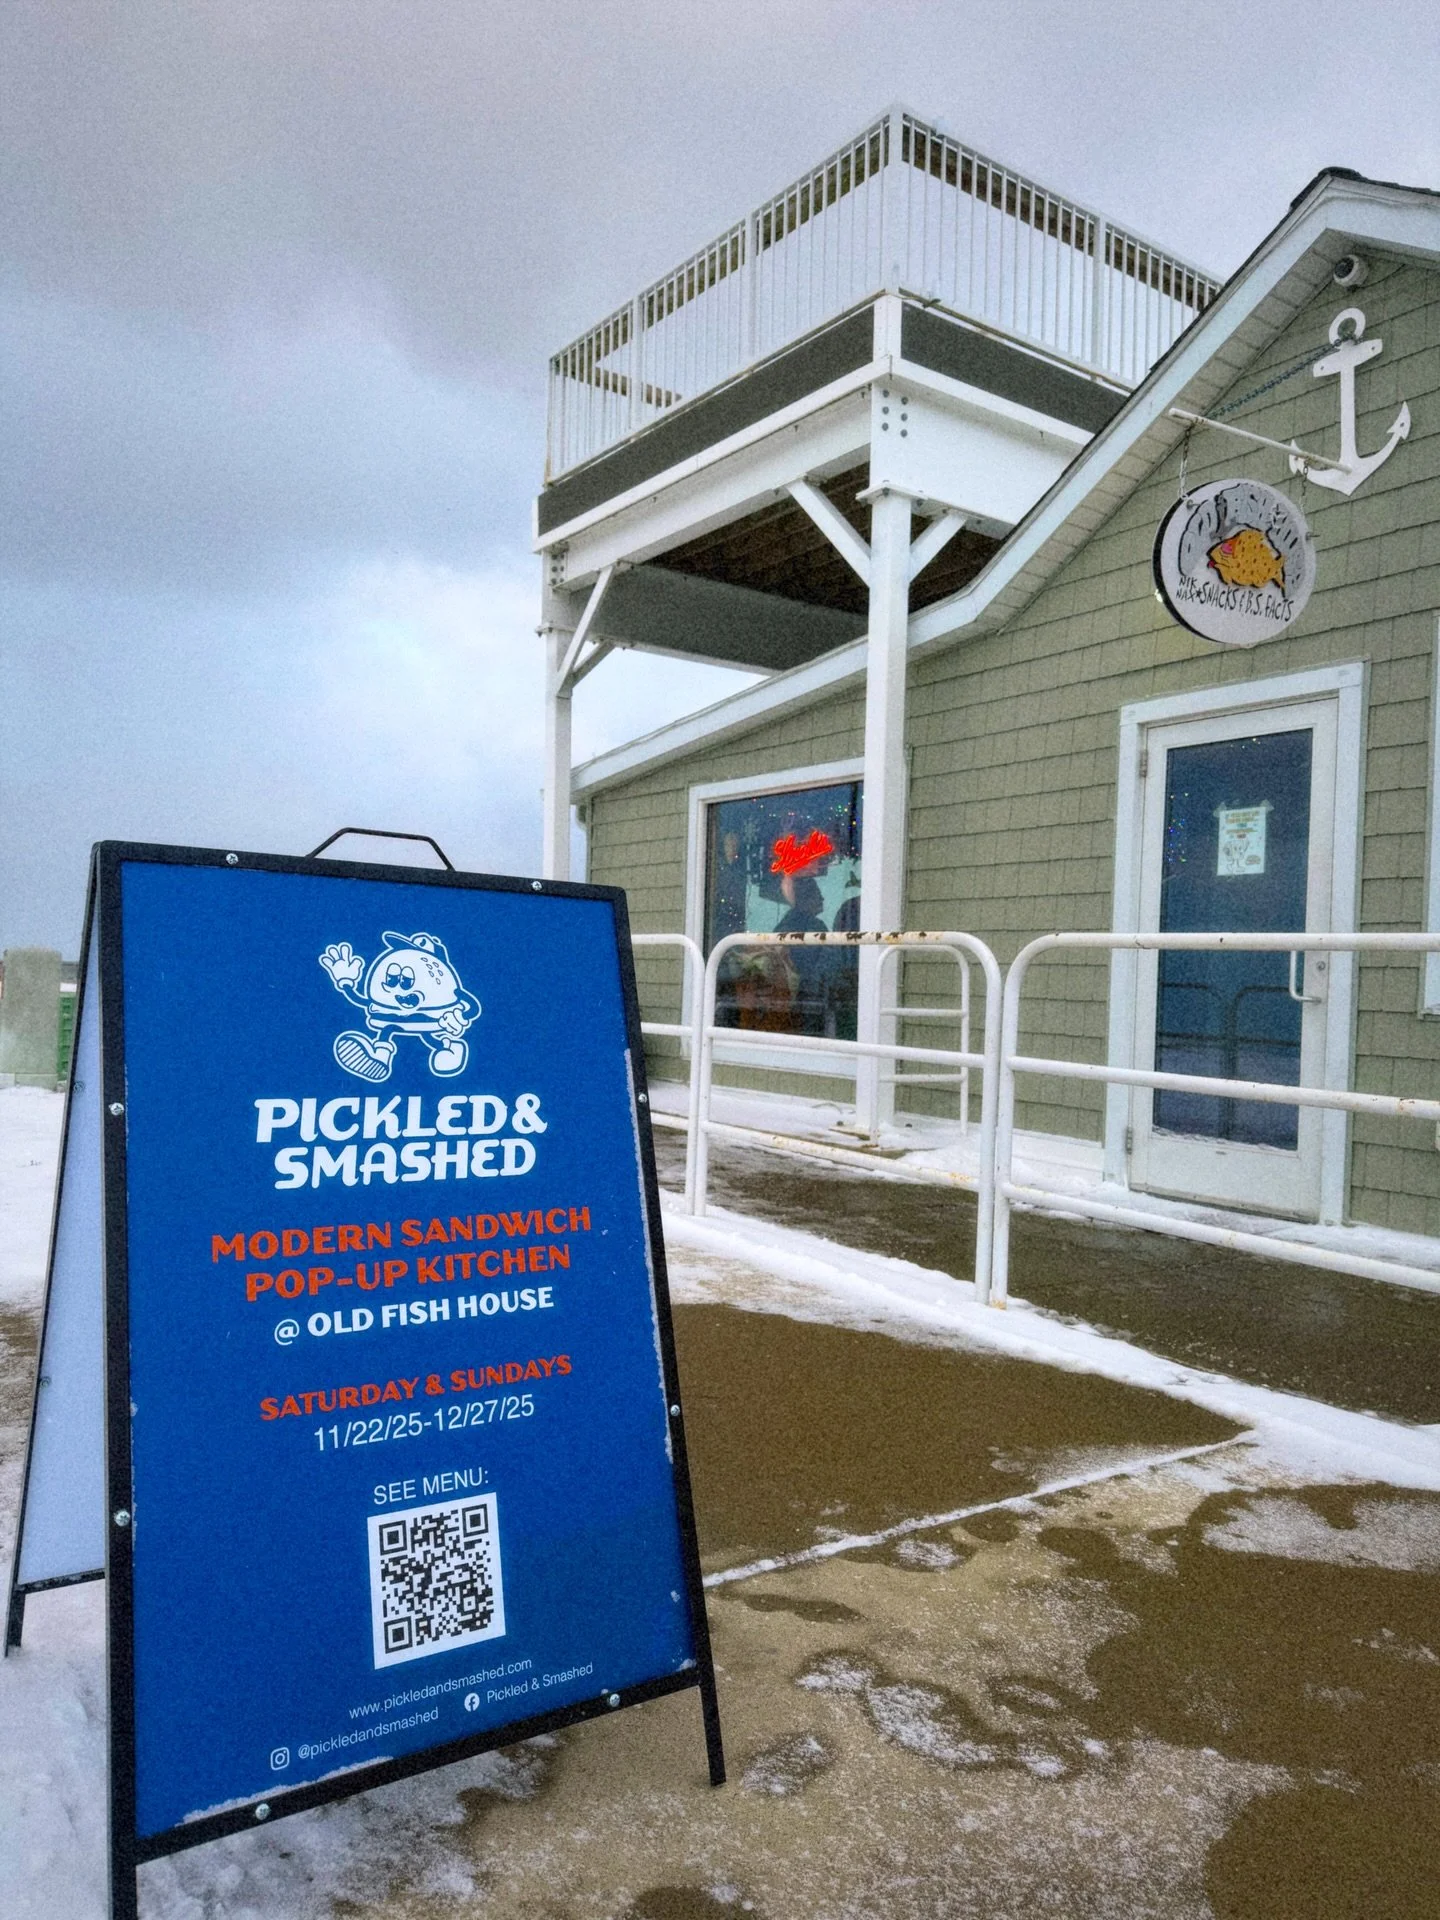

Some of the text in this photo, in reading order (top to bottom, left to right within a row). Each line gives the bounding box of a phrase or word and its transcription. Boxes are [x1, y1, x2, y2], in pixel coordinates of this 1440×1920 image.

[1179, 576, 1197, 588] NIK
[1199, 581, 1239, 610] SNACKS
[1265, 594, 1294, 622] FACTS
[275, 1138, 536, 1189] SMASHED
[212, 1207, 590, 1262] MODERN SANDWICH
[246, 1244, 570, 1301] POP-UP KITCHEN
[275, 1287, 554, 1345] @ OLD FISH HOUSE
[260, 1355, 571, 1420] SATURDAY & SUNDAYS
[315, 1394, 534, 1450] 11/22/25-12/27/25
[374, 1467, 490, 1504] SEE MENU:
[297, 1662, 593, 1760] @pickledandsmashed Pickled & Smashed
[348, 1657, 532, 1720] www.pickledandsmashed.com
